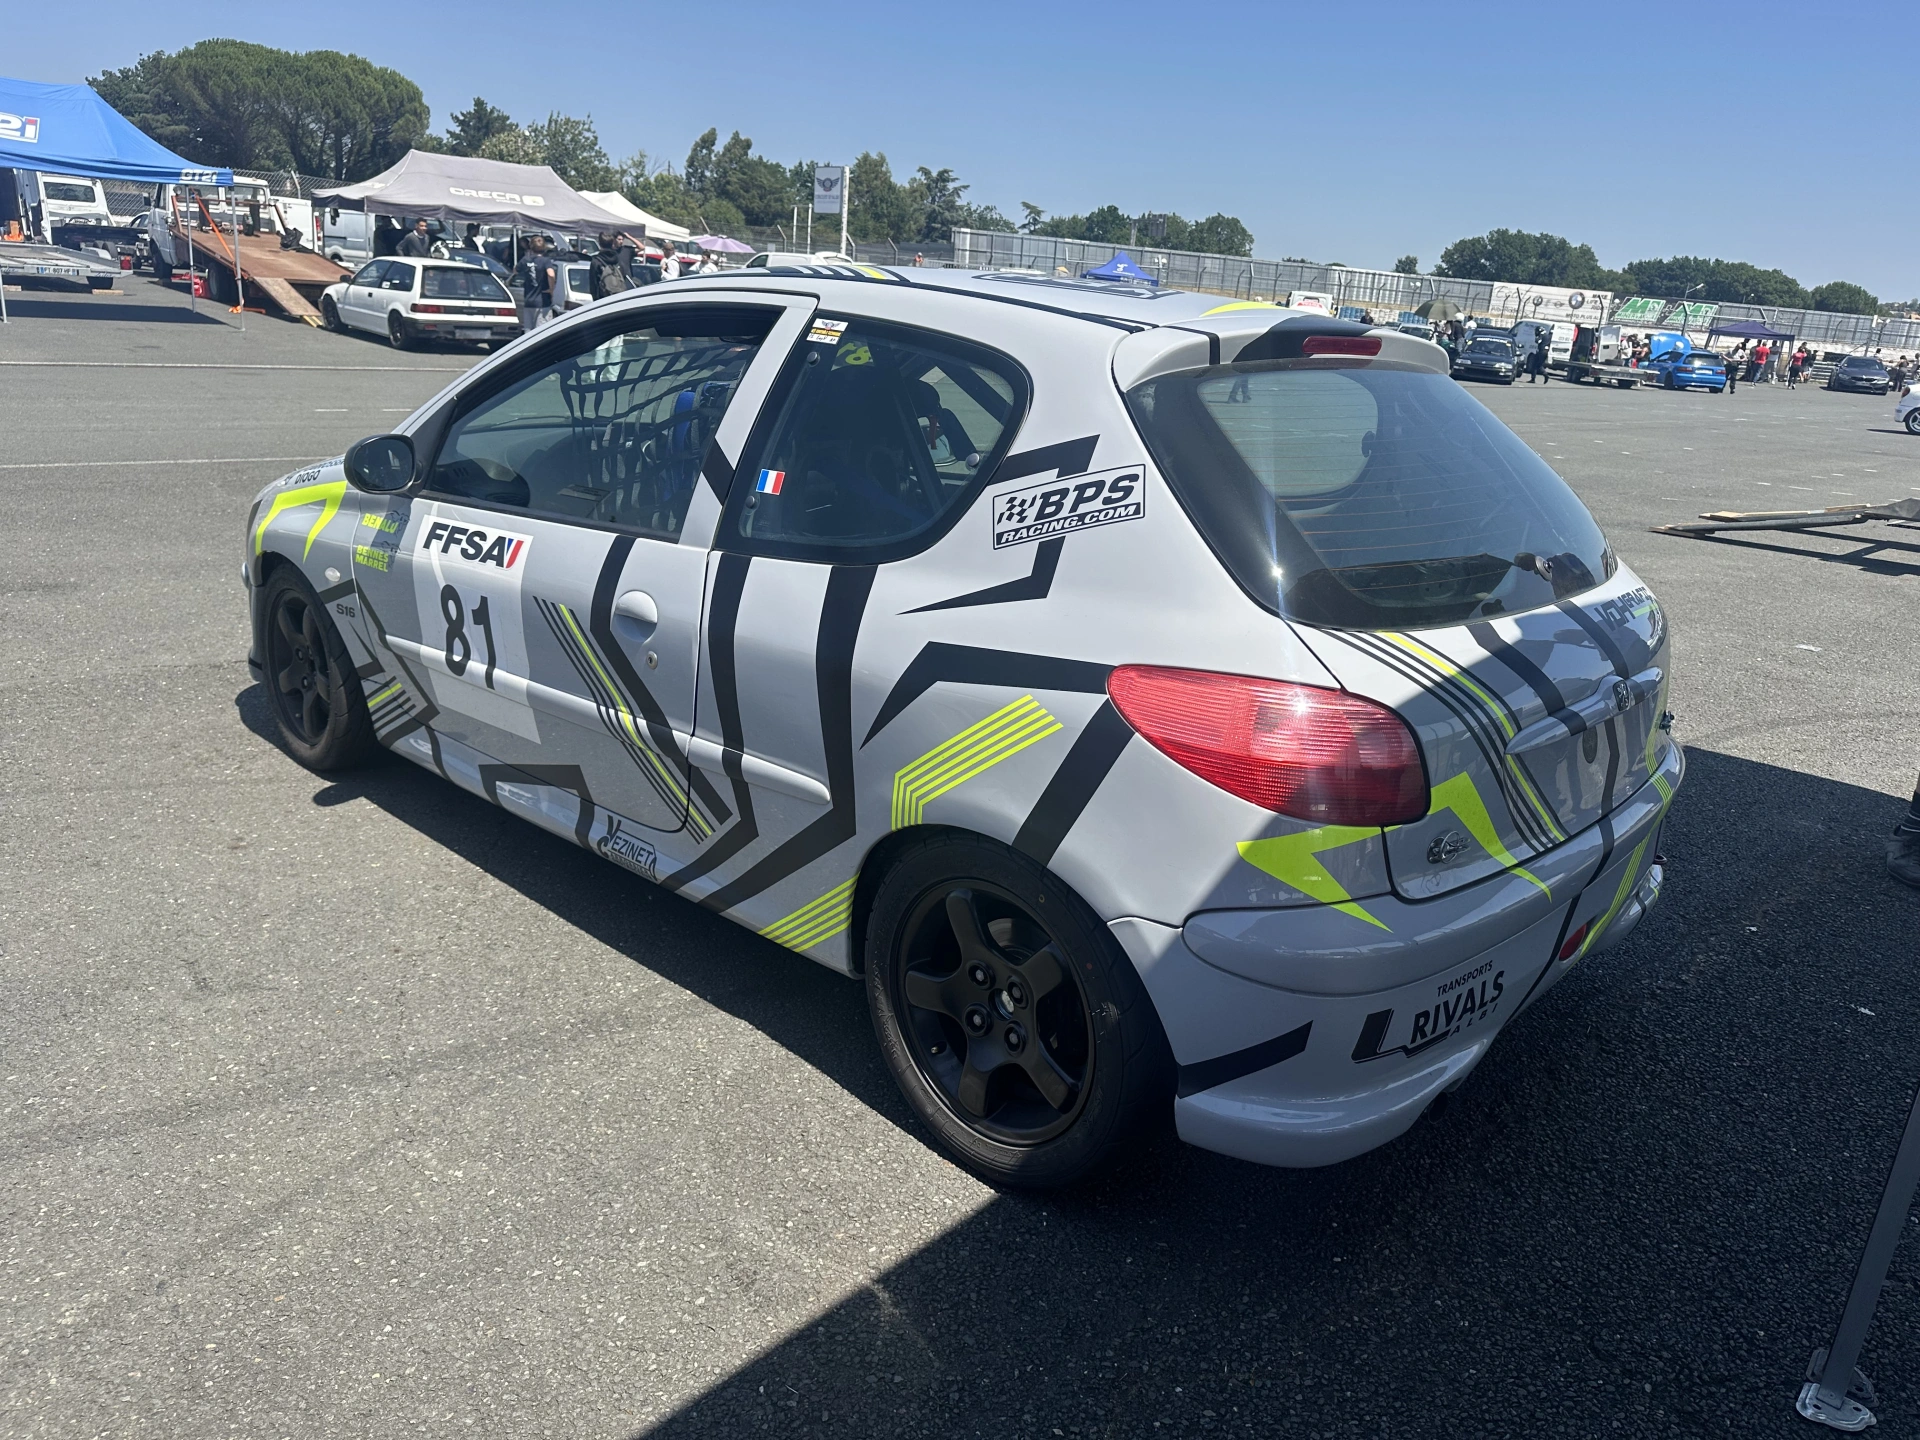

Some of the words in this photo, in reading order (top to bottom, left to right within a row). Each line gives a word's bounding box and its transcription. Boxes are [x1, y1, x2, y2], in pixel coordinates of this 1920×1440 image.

[449, 187, 521, 202] ORECA
[294, 469, 321, 485] DIOGO
[1033, 473, 1140, 522] BPS
[361, 512, 399, 534] BENALU
[1000, 504, 1138, 544] RACING.COM
[356, 544, 389, 563] BENNES
[423, 521, 508, 569] FFSA
[355, 553, 389, 573] MARREL
[336, 603, 355, 618] S16
[440, 584, 497, 690] 81
[607, 814, 654, 867] VEZINET
[1437, 960, 1493, 997] TRANSPORTS
[1410, 970, 1505, 1045] RIVALS
[1450, 1003, 1498, 1037] ALBI
